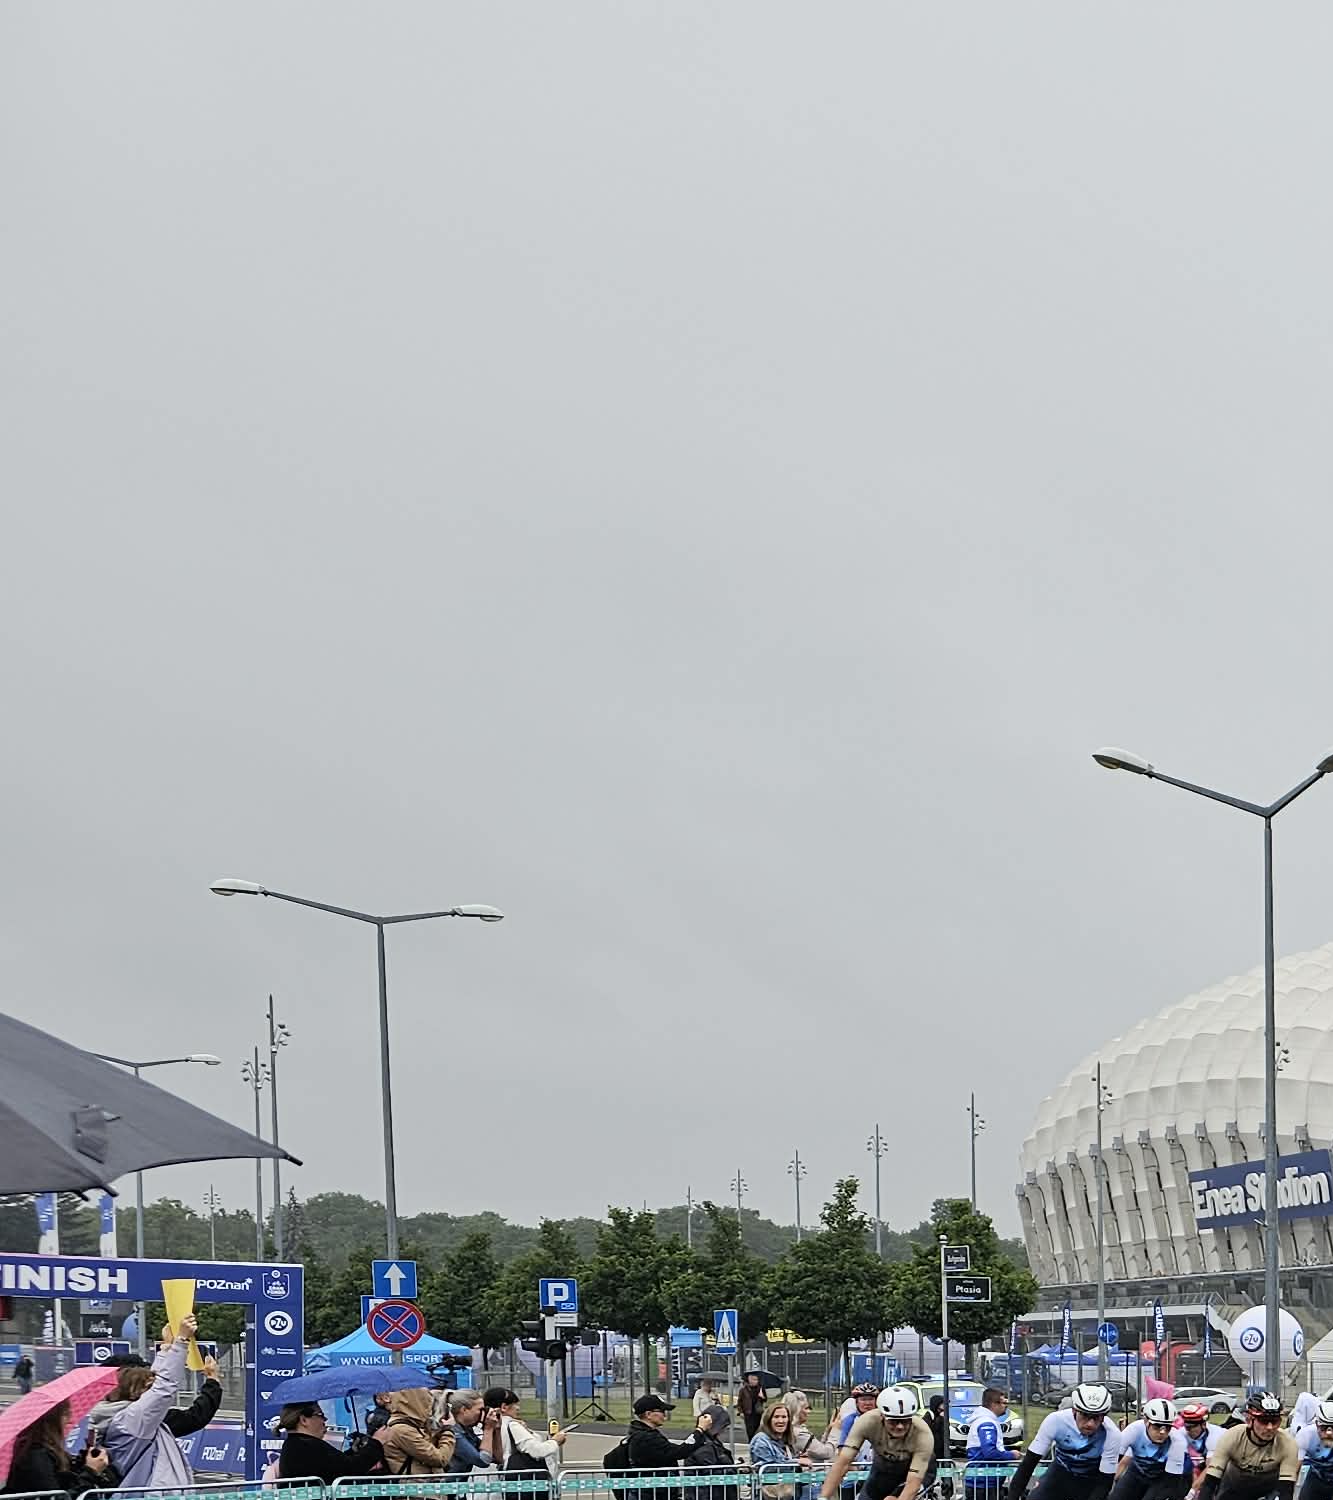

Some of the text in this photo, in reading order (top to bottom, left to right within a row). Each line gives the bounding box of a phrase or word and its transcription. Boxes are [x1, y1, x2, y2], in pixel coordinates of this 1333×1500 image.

[1191, 1180, 1247, 1218] Enea
[0, 1264, 128, 1293] INISH
[955, 1285, 982, 1294] Ptasia
[547, 1282, 569, 1306] P
